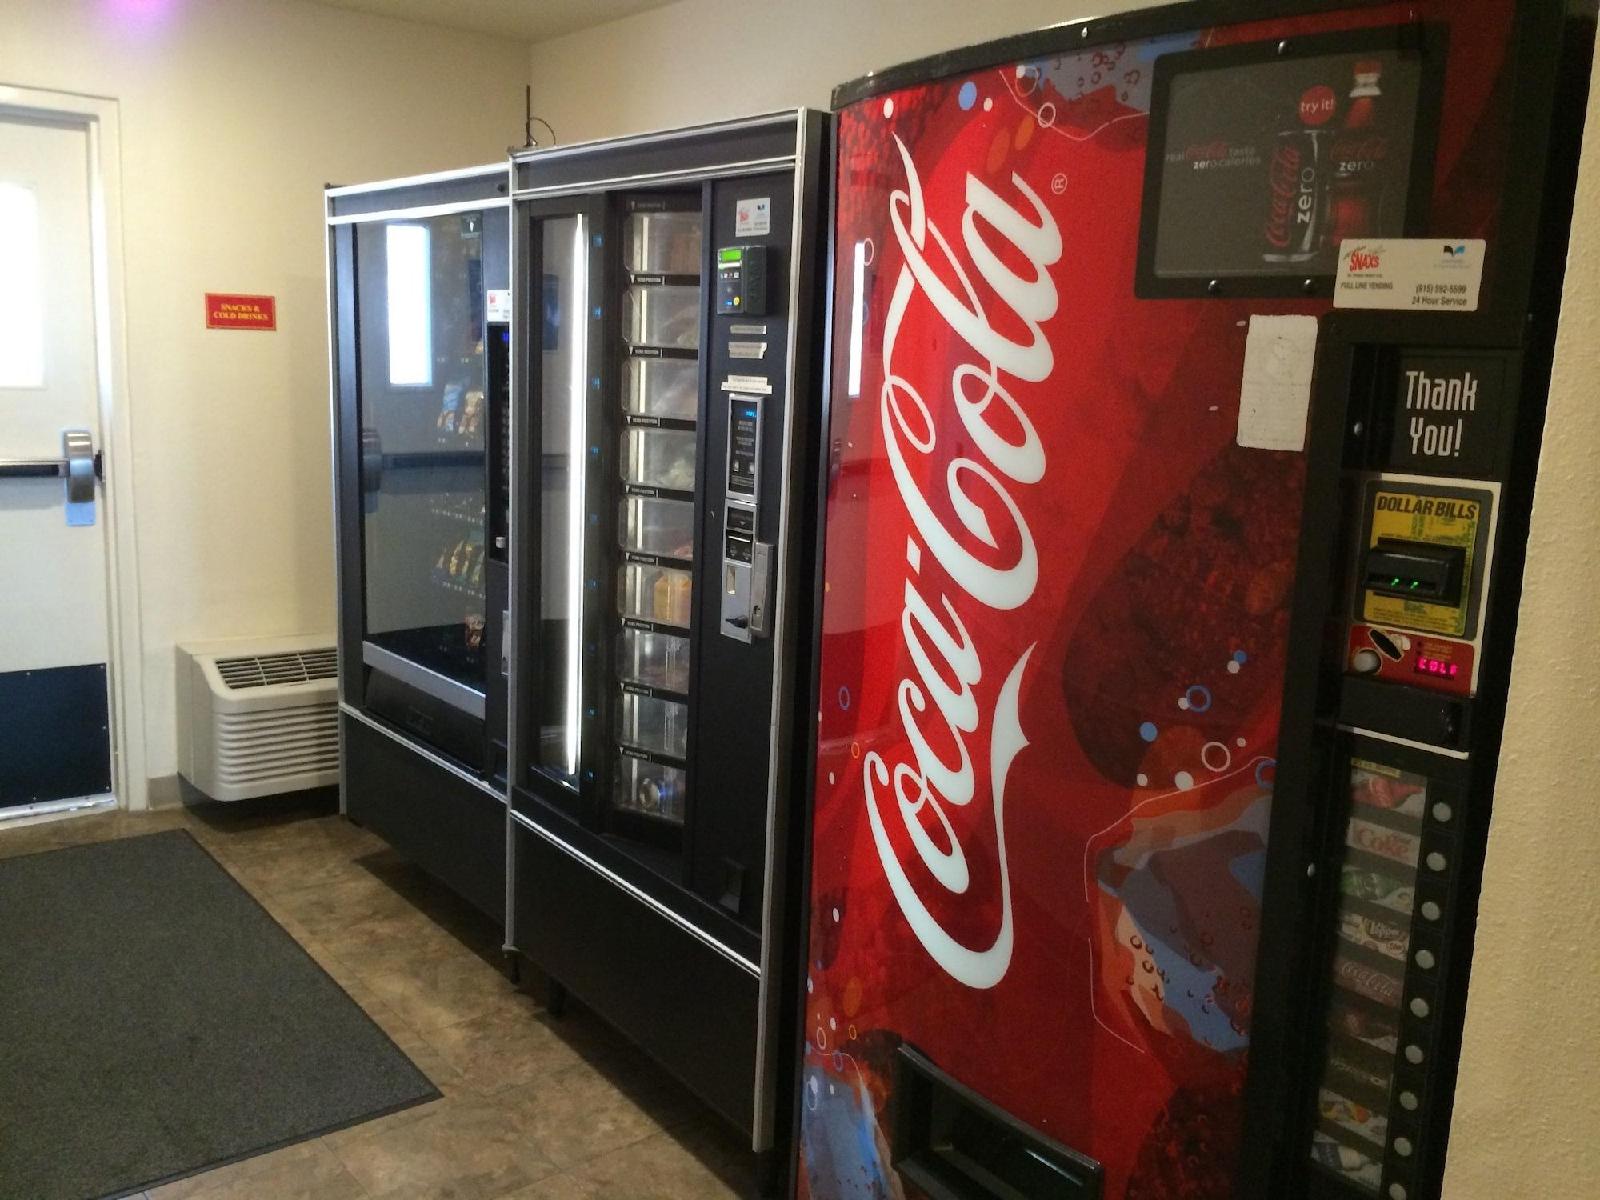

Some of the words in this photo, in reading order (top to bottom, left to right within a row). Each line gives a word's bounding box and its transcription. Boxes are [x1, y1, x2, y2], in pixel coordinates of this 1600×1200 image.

[1300, 101, 1319, 114] try
[1321, 97, 1334, 110] it!
[1338, 160, 1375, 172] zero
[1296, 167, 1315, 224] zero
[1411, 295, 1420, 305] 24
[1421, 296, 1439, 306] Hour
[1441, 297, 1468, 307] Service
[1406, 370, 1479, 412] Thank
[1409, 416, 1463, 458] You!
[1376, 495, 1434, 516] DOLLAR
[1434, 502, 1478, 521] BILLS
[864, 130, 1063, 991] Coca-Cola
